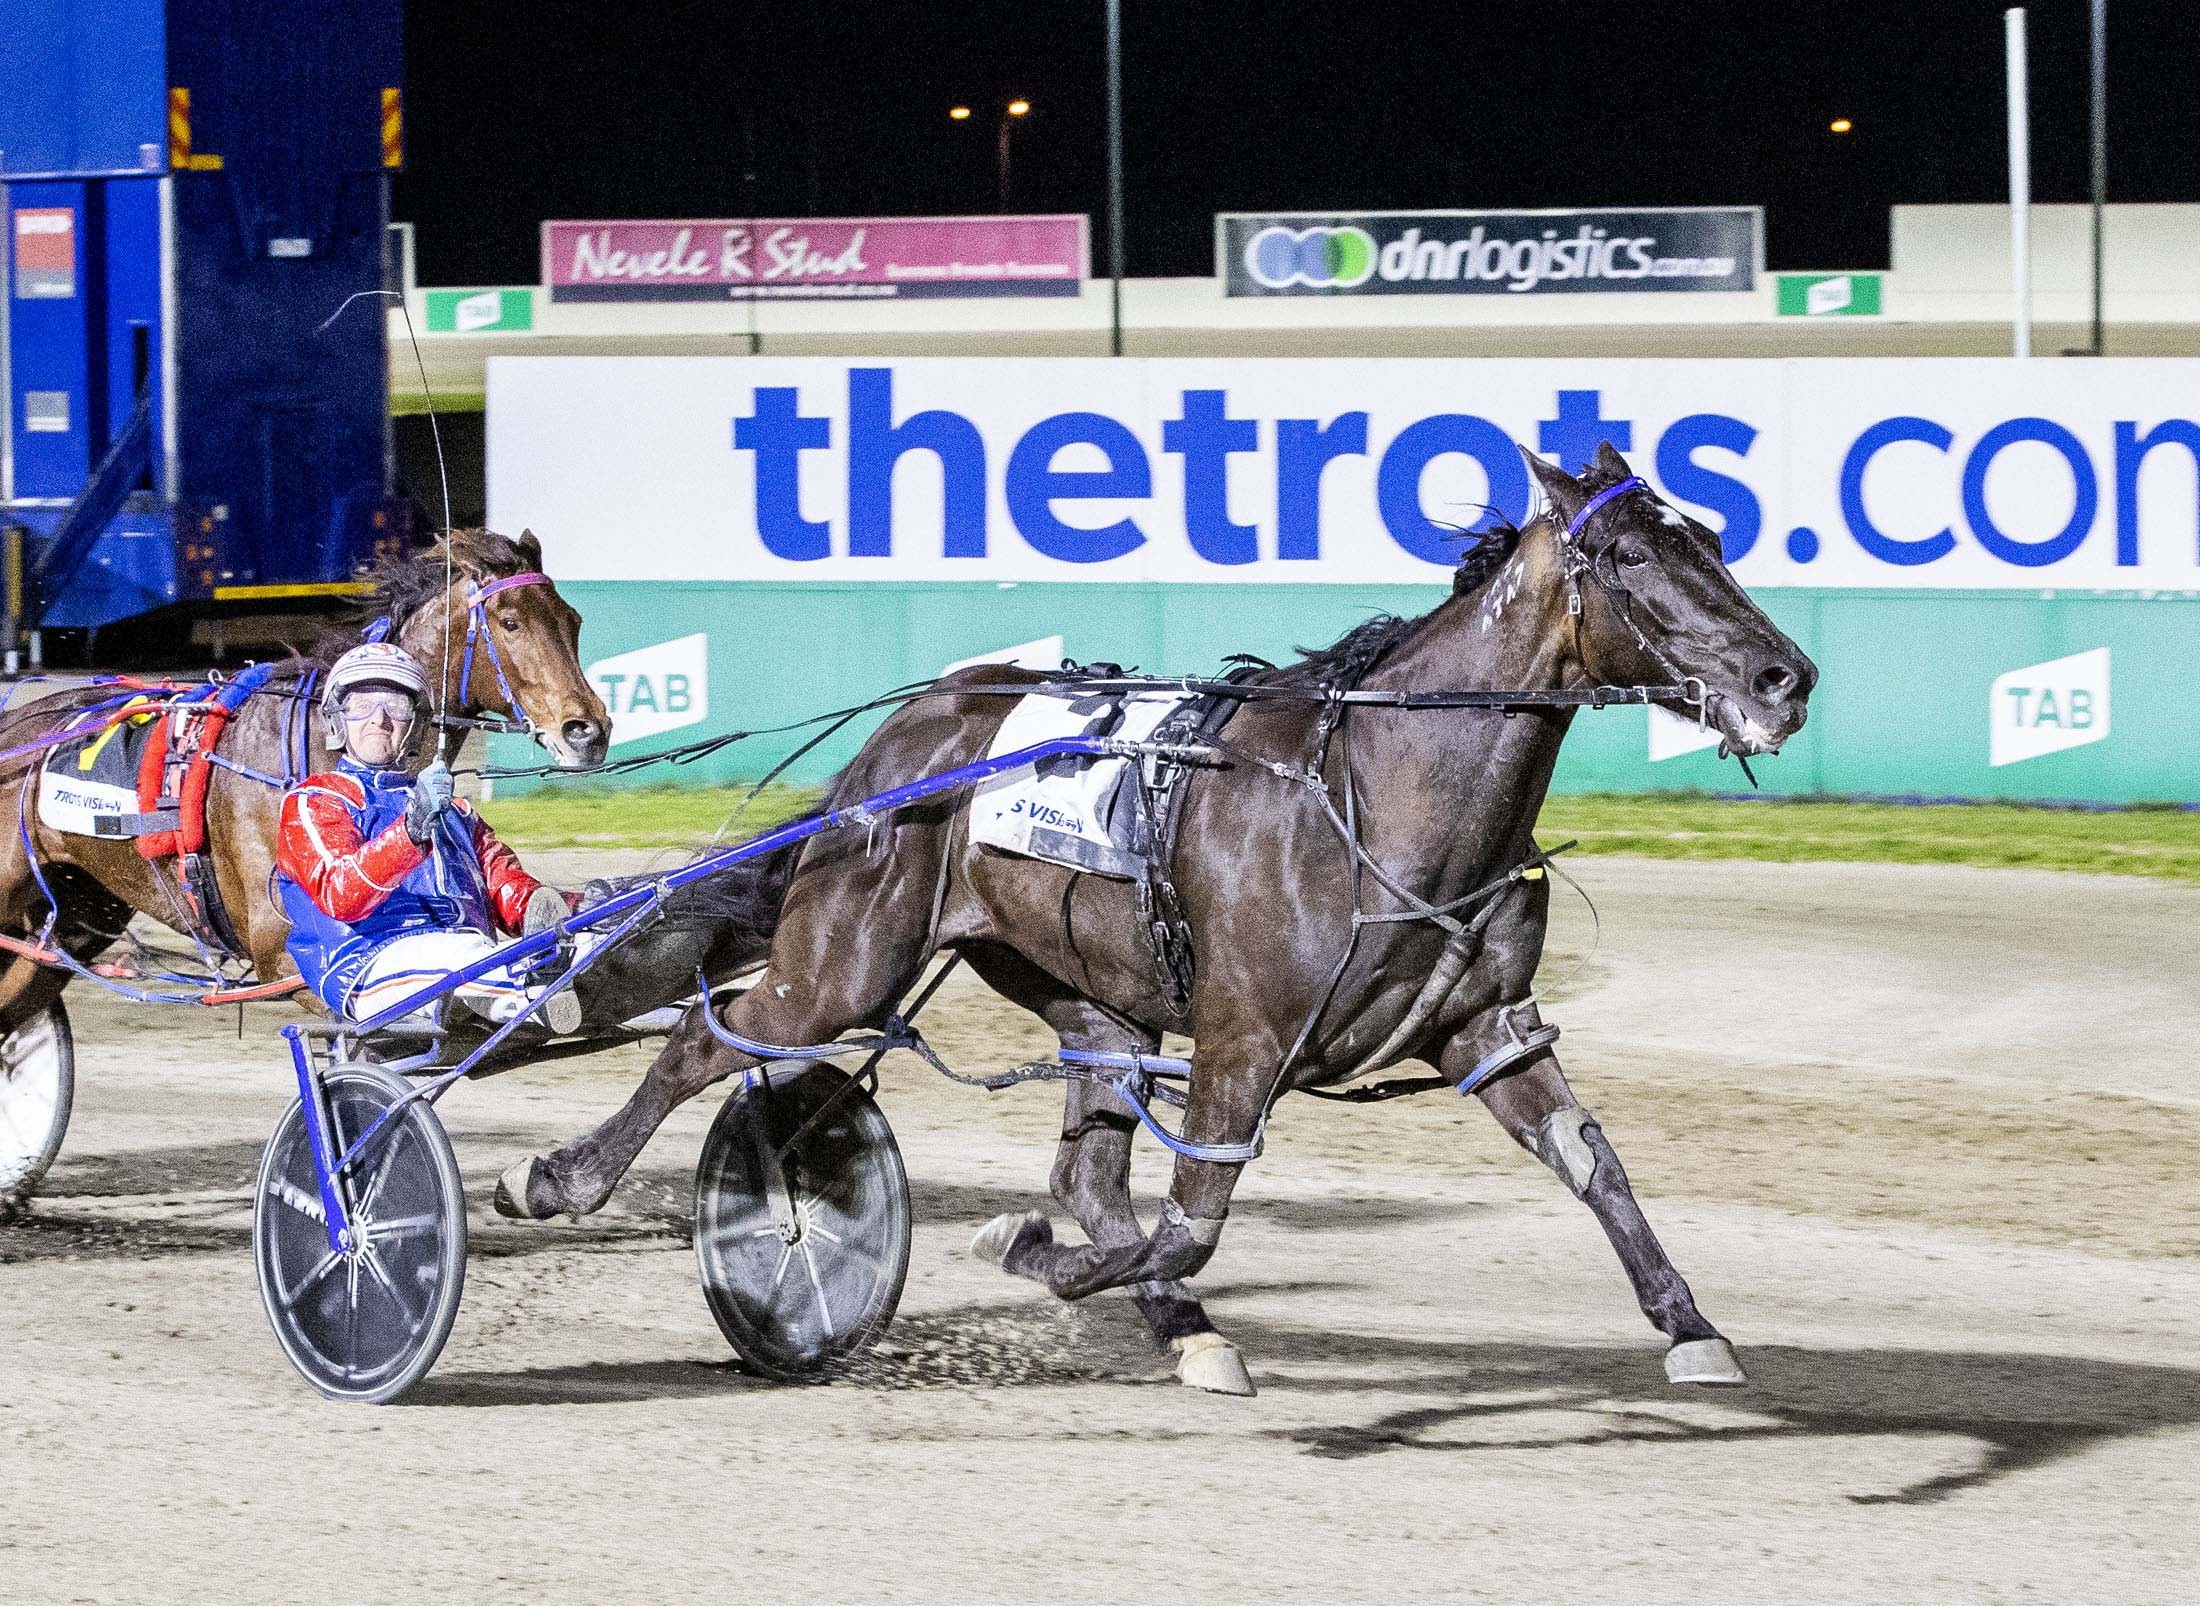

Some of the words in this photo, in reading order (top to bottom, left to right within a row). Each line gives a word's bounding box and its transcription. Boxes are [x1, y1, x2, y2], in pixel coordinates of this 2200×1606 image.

[571, 229, 711, 280] Nevele
[719, 228, 752, 278] R
[763, 227, 867, 279] Stud
[1377, 225, 1735, 291] dnrlogistics
[598, 673, 691, 713] TAB
[2007, 687, 2094, 730] TAB
